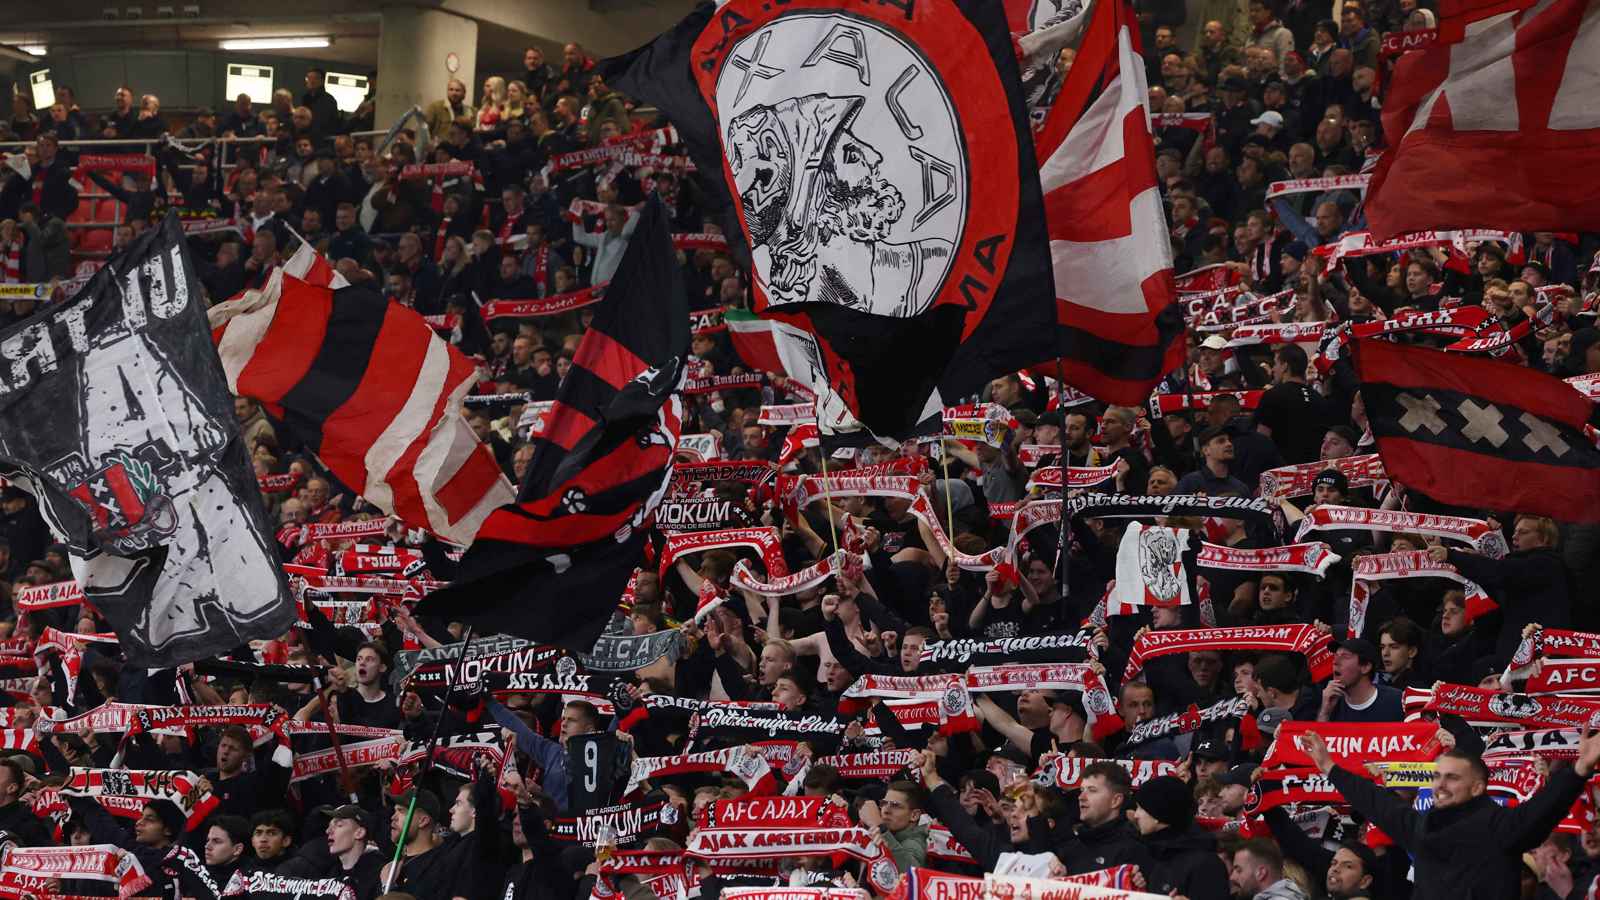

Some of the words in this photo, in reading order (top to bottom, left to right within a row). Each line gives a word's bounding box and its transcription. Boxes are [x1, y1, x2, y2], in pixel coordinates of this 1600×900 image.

[1403, 230, 1437, 243] AJAX
[21, 588, 50, 604] AJAX
[60, 582, 83, 600] AJA
[1141, 634, 1184, 649] AJAX
[1188, 626, 1292, 642] AMSTERDAM
[445, 648, 535, 686] MOKUM
[1546, 667, 1597, 685] AFC
[507, 672, 539, 690] AFC
[542, 672, 591, 691] AJAX
[152, 708, 185, 722] AJAX
[189, 706, 267, 719] AMSTERDAM
[1324, 735, 1364, 758] ZIJN
[1487, 730, 1582, 750] AJA
[584, 740, 598, 793] 9
[852, 750, 911, 767] AMSTERD
[722, 800, 760, 822] AFC
[760, 799, 814, 821] AJAX
[576, 808, 642, 842] MOKUM
[699, 832, 748, 852] AJAX
[752, 830, 873, 851] AMSTERDAM
[602, 855, 652, 870] AJAX
[14, 873, 47, 889] AJAX
